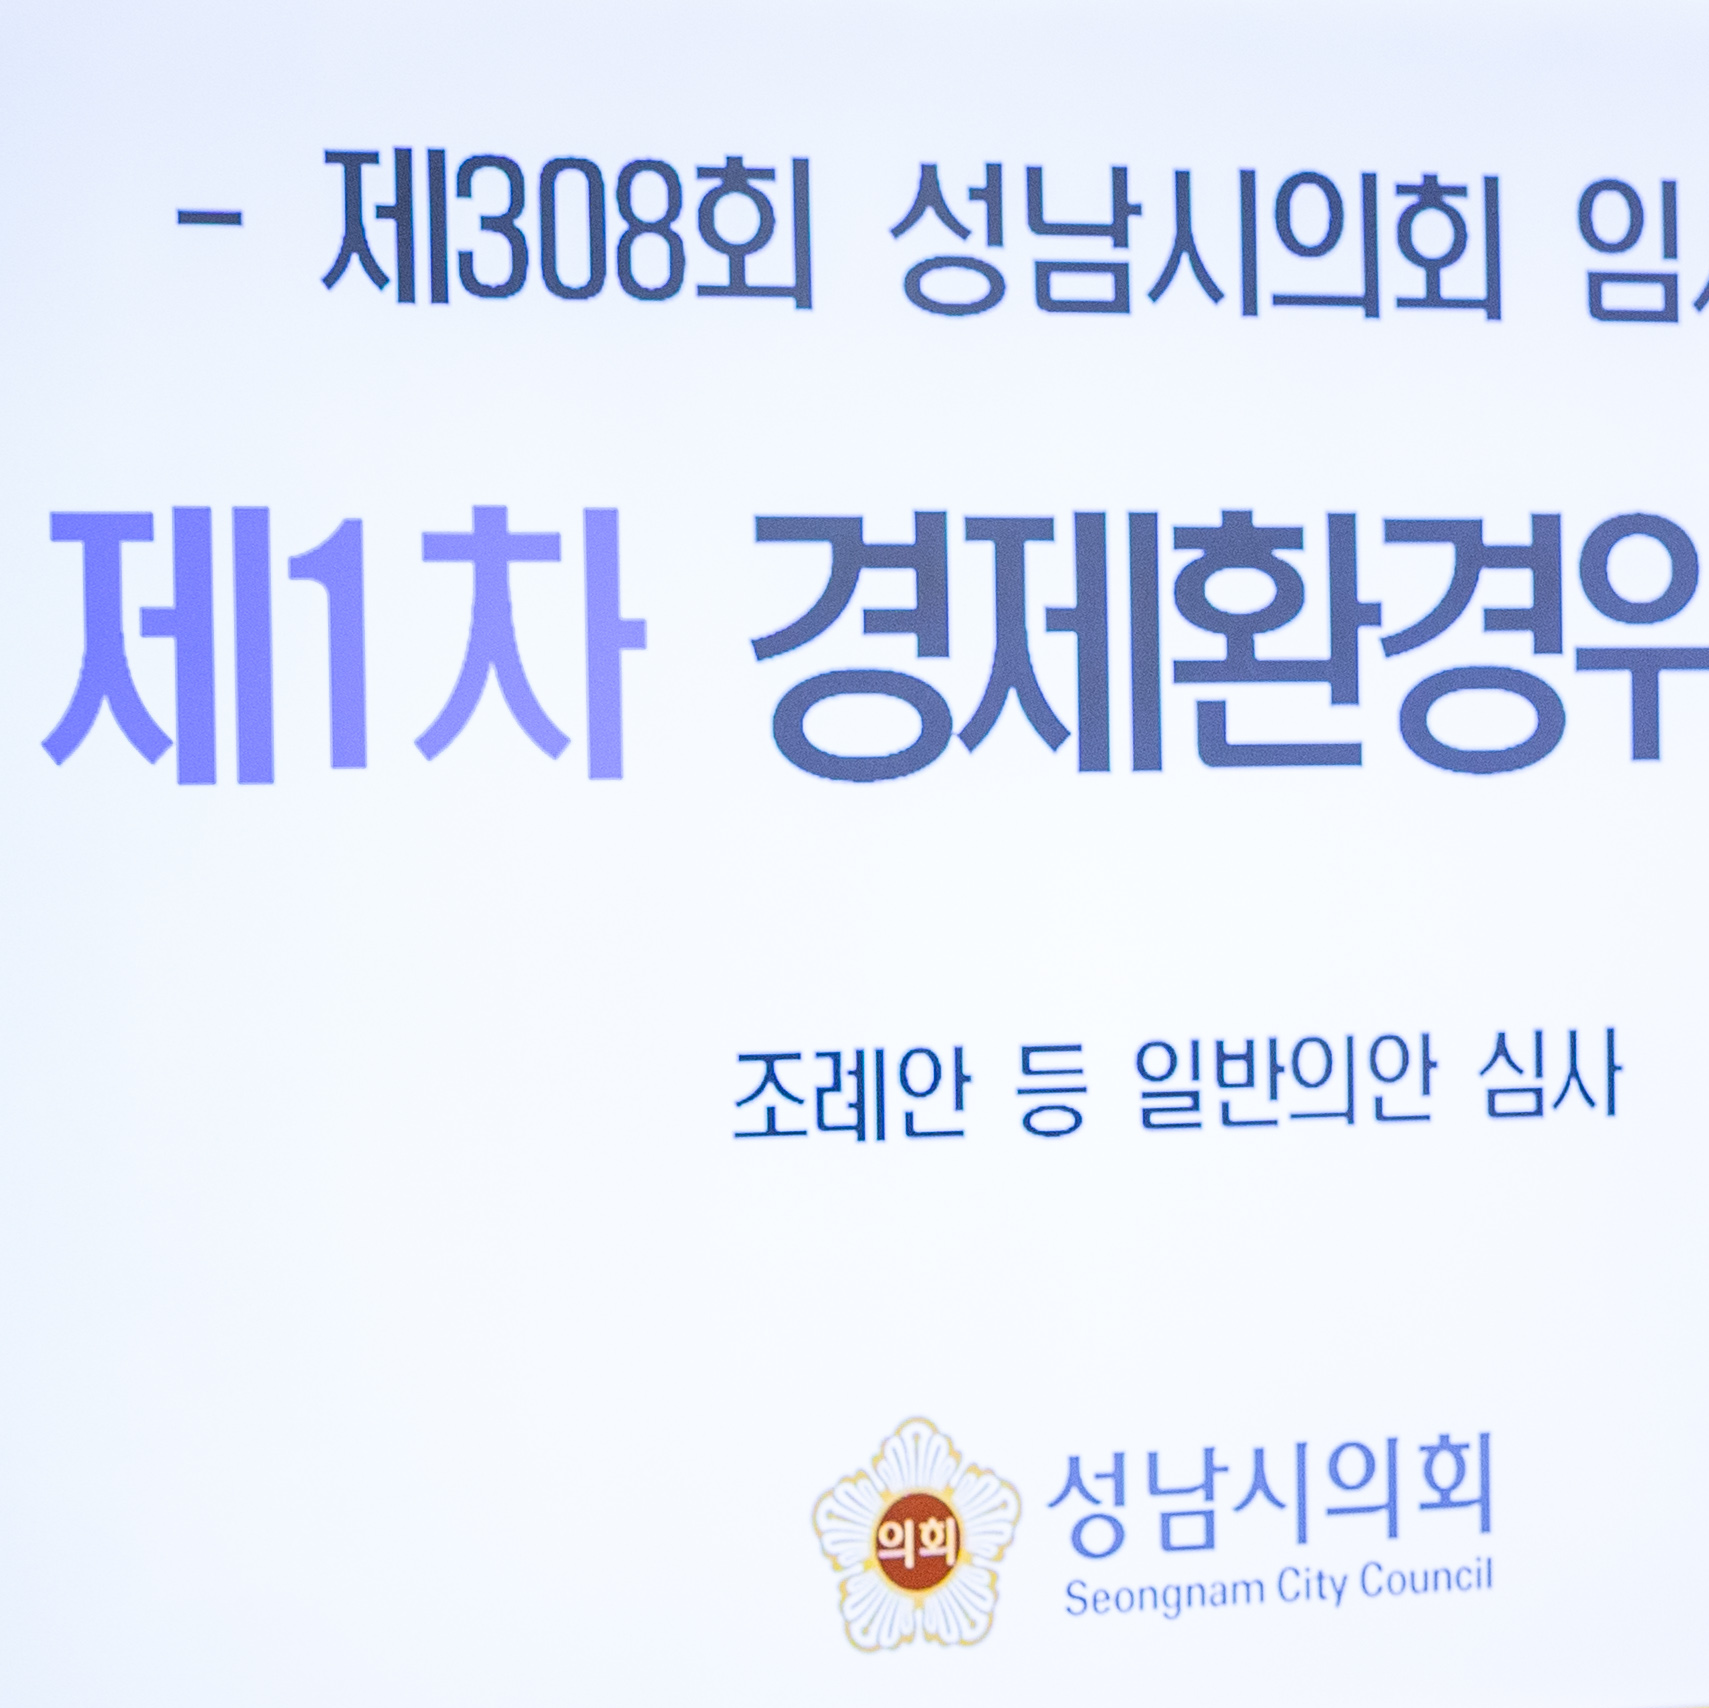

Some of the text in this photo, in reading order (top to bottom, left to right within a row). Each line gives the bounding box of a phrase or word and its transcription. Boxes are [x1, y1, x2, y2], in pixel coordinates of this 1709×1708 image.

[321, 146, 813, 310] 제308회
[890, 162, 1502, 321] 성남시의회
[41, 505, 646, 786] 제1차
[734, 1027, 1623, 1142] 조례안 등 일반의안 심사
[877, 1513, 960, 1570] 의회
[1047, 1432, 1491, 1558] 성남시의회
[1065, 1557, 1493, 1620] Seongnam City Council
